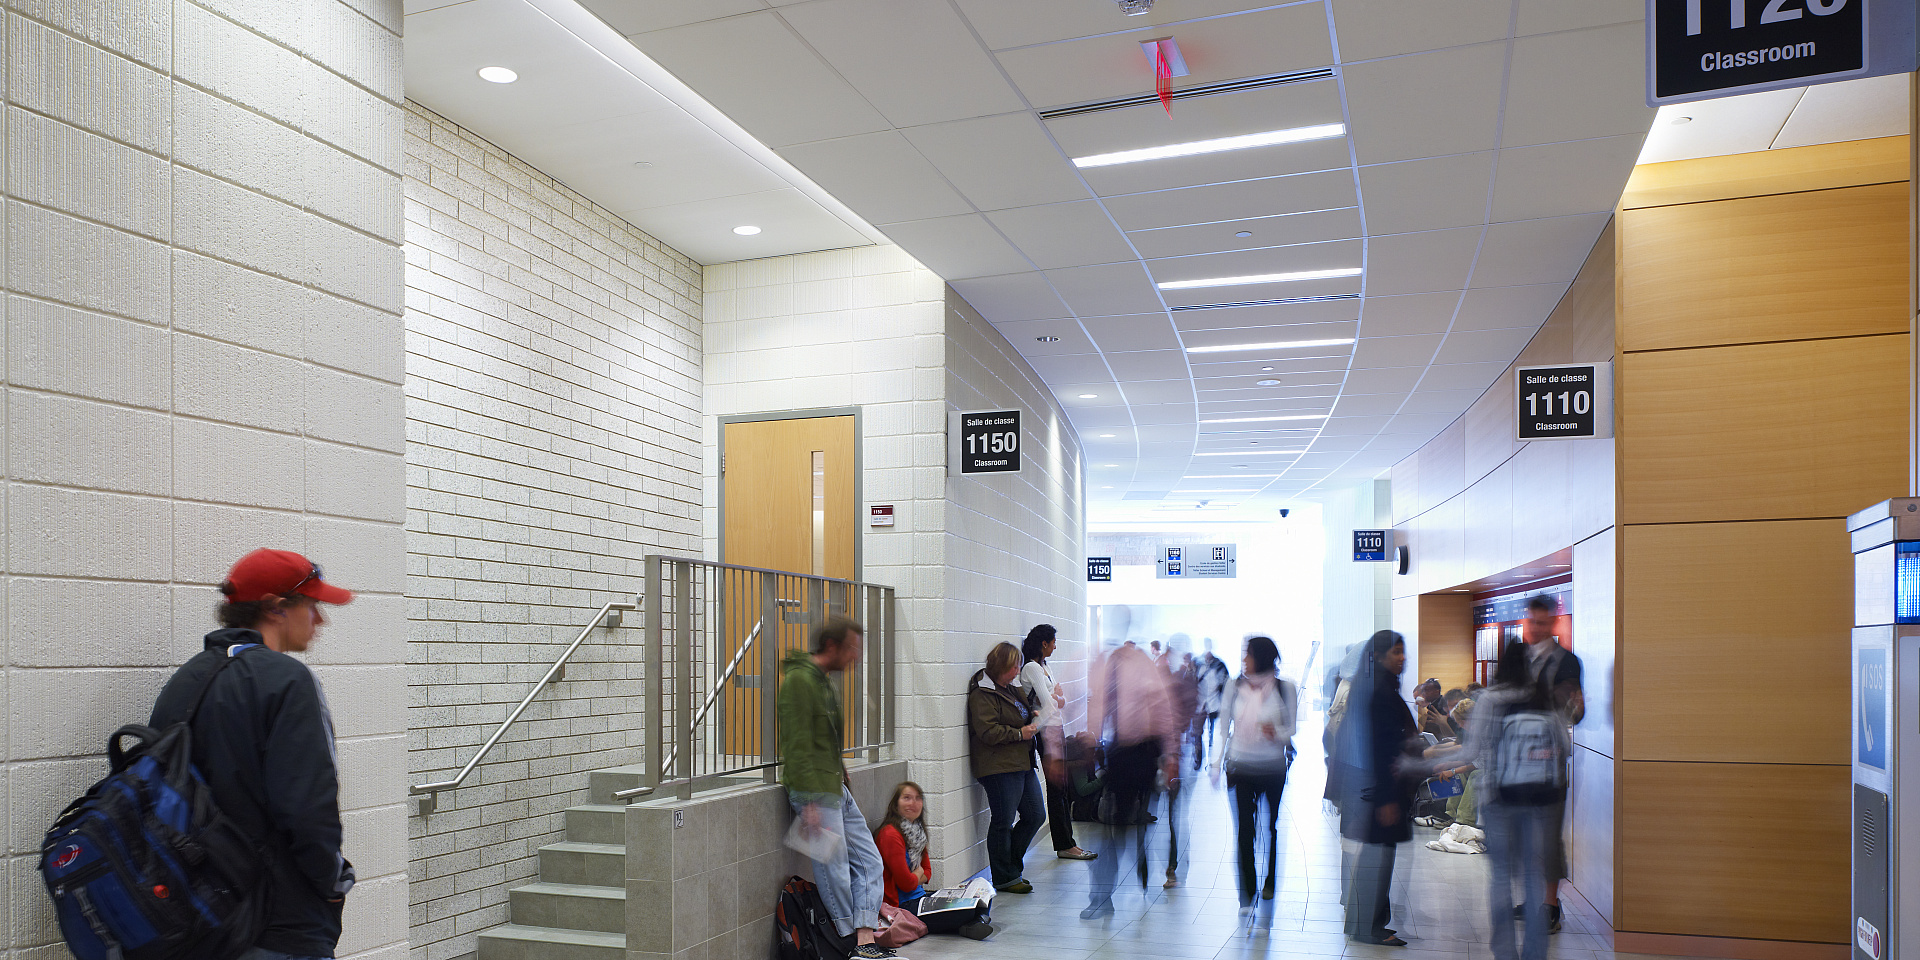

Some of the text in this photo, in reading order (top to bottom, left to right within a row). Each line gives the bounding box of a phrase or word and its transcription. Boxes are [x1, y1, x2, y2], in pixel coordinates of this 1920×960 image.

[1701, 41, 1816, 72] Classroom
[1526, 374, 1587, 384] Salle de classe
[1525, 390, 1590, 416] 1110
[1535, 422, 1578, 431] Classroom
[966, 431, 1017, 454] 1150
[974, 459, 1008, 467] Classroom
[1357, 537, 1382, 548] 1110
[1088, 565, 1110, 574] 1150
[1869, 664, 1883, 690] SOS
